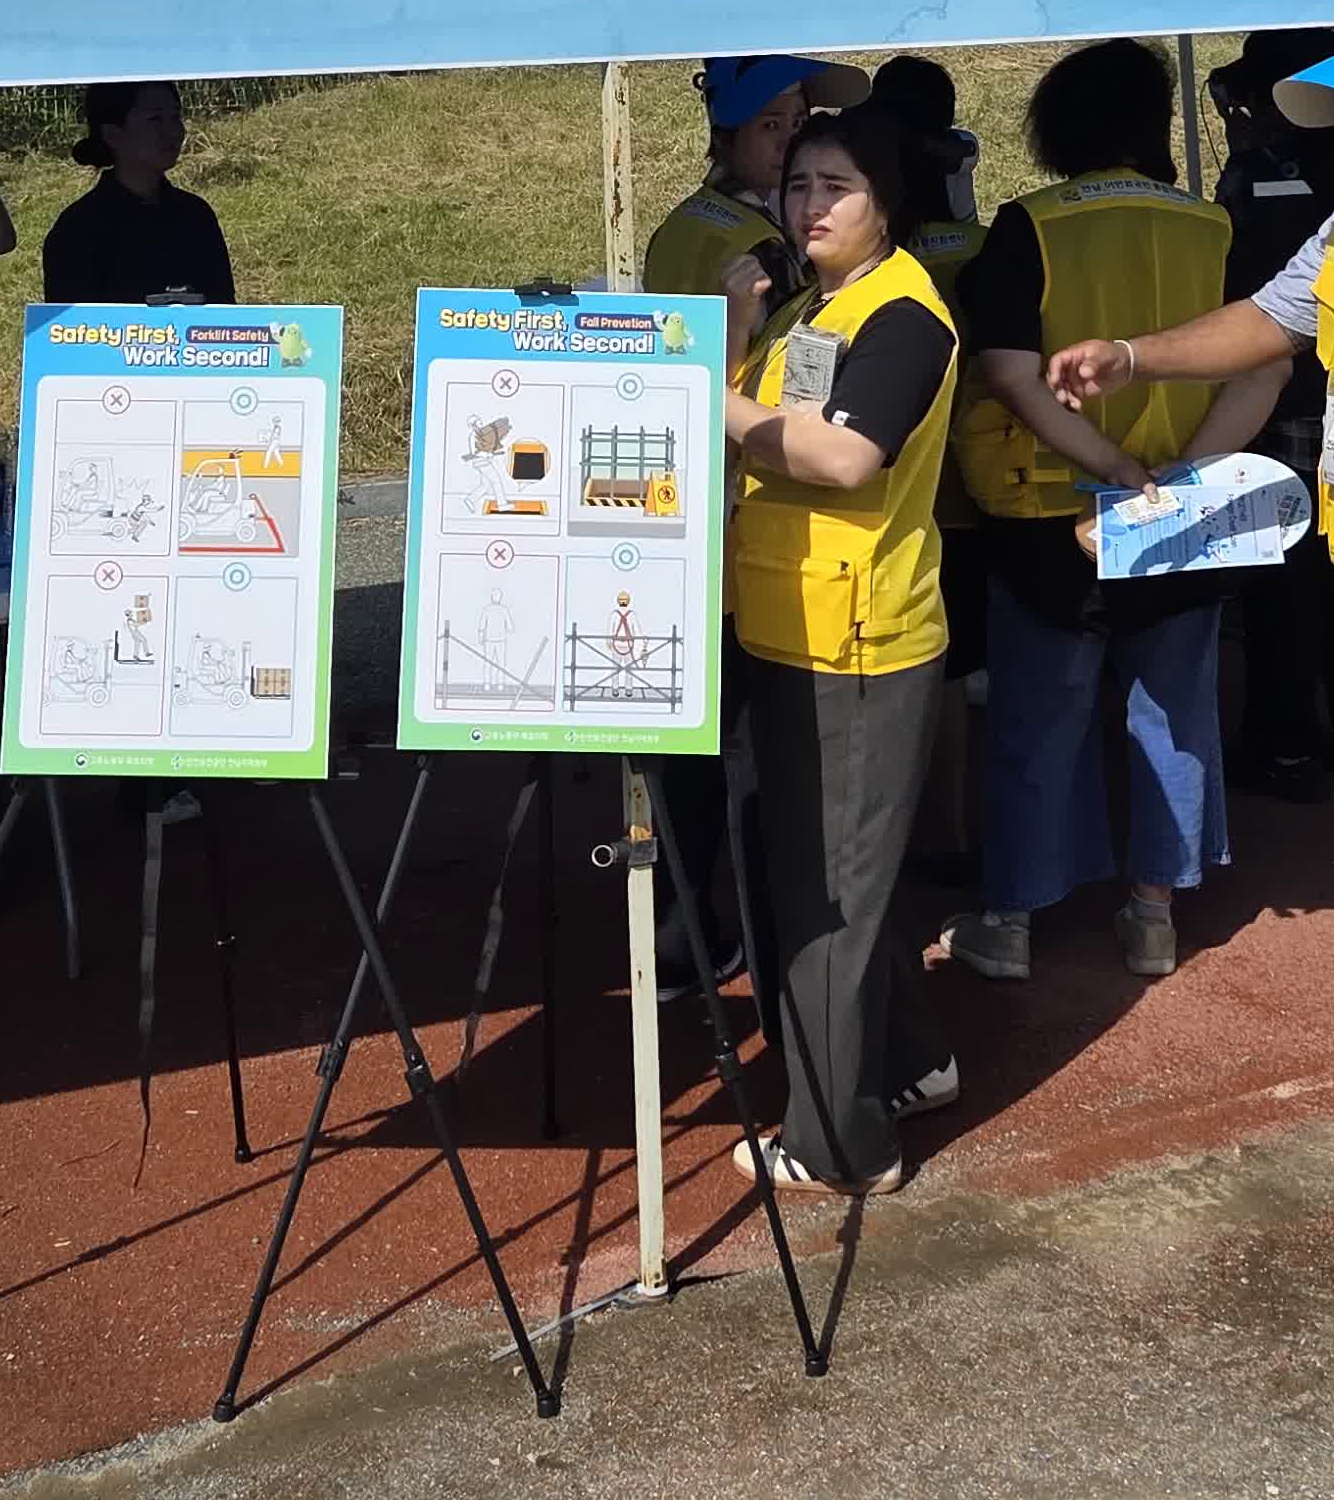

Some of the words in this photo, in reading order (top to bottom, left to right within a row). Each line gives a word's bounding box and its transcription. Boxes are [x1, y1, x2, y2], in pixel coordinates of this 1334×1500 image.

[440, 309, 511, 332] Safety
[514, 310, 569, 332] First,
[580, 316, 600, 328] Fall
[50, 324, 122, 346] Safety
[125, 324, 180, 345] First,
[191, 329, 230, 342] Forklift
[232, 330, 269, 344] Safety
[513, 331, 567, 352] Work
[569, 333, 655, 354] Second!
[123, 346, 178, 367] Work
[182, 346, 270, 367] Second!
